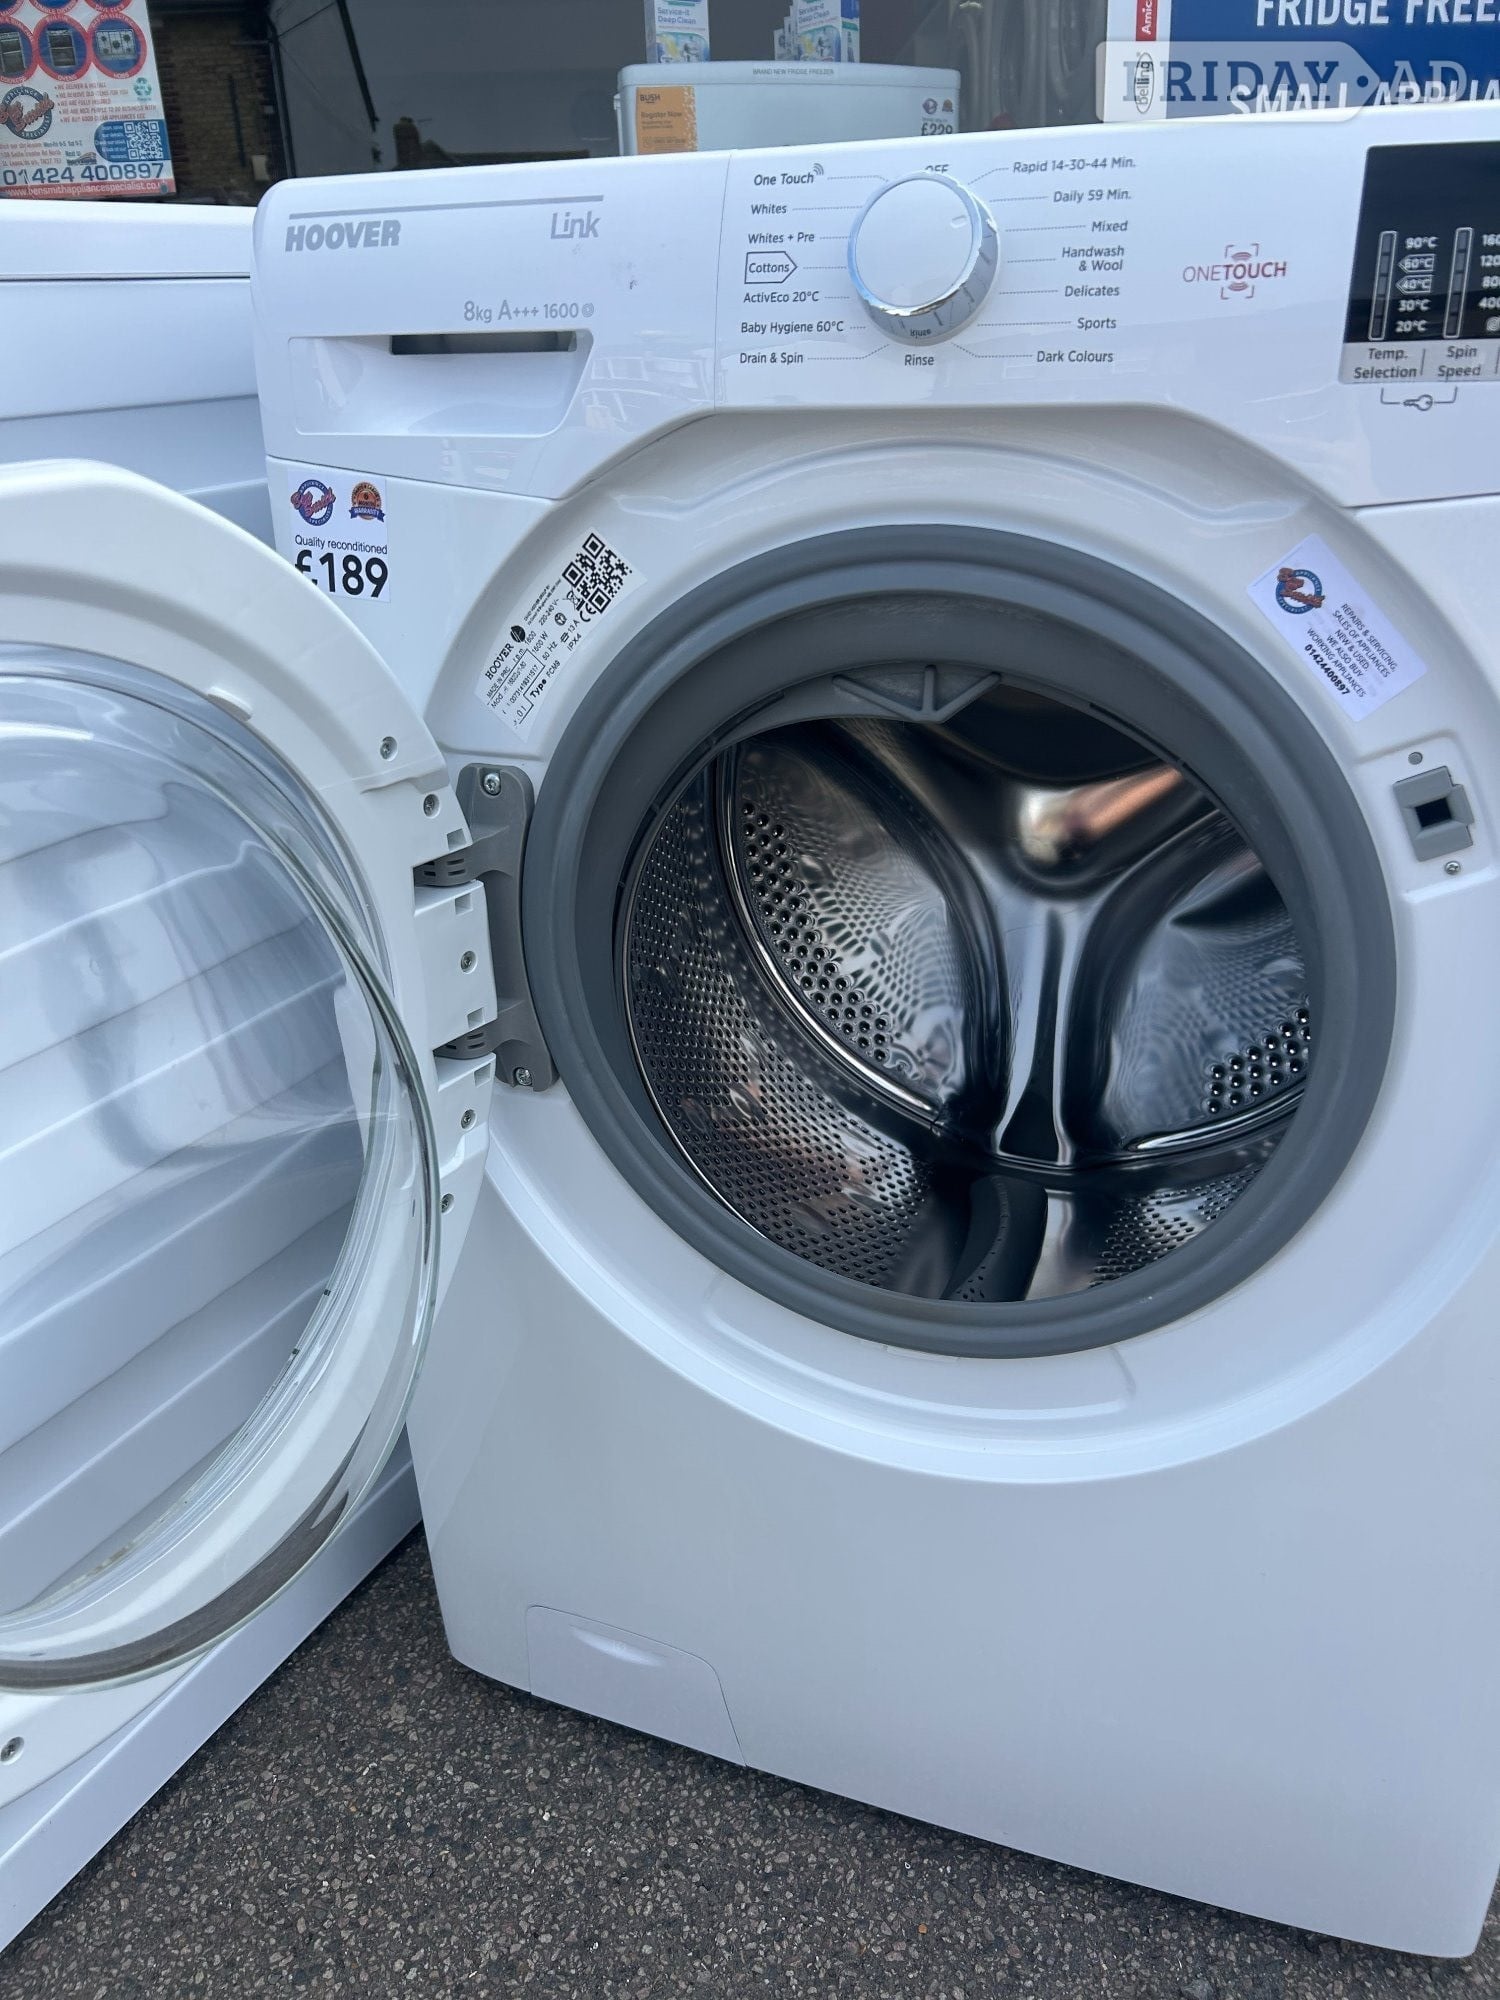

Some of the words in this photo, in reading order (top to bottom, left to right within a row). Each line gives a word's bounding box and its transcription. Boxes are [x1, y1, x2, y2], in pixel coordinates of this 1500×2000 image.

[1256, 0, 1389, 27] FRIDGE
[1405, 0, 1500, 25] FREE
[640, 94, 661, 102] BUSH
[1013, 161, 1048, 174] Rapid
[1052, 158, 1107, 171] 14-30-44
[1111, 156, 1136, 168] Min.
[3, 166, 74, 186] 01424
[81, 163, 163, 182] 400897
[753, 174, 777, 186] One
[781, 172, 814, 185] Touch
[1053, 190, 1084, 204] Daily
[1087, 190, 1103, 201] 59
[1107, 188, 1132, 201] Min.
[751, 203, 787, 215] Whites
[550, 211, 600, 240] Link
[1091, 220, 1129, 232] Mixed
[285, 219, 401, 252] HOOVER
[748, 232, 784, 244] Whites
[787, 234, 794, 242] +
[797, 232, 815, 243] Pre
[1062, 245, 1125, 258] Handwash
[748, 263, 790, 274] Cottons
[1078, 261, 1087, 272] &
[1091, 259, 1124, 272] Wool
[1183, 262, 1288, 283] ONETOUCH
[1482, 275, 1500, 289] 80
[743, 293, 790, 303] ActivEco
[1064, 285, 1120, 297] Delicates
[463, 301, 492, 323] 8kg
[498, 299, 539, 321] A+++
[543, 302, 579, 320] 1600
[741, 322, 767, 335] Baby
[770, 321, 814, 335] Hygiene
[1077, 317, 1117, 330] Sports
[740, 353, 767, 364] Drain
[770, 353, 778, 364] &
[781, 352, 804, 365] Spin
[904, 355, 935, 366] Rinse
[1036, 351, 1064, 363] Dark
[1067, 350, 1114, 363] Colours
[1368, 347, 1407, 362] Temp.
[1446, 345, 1477, 359] Spin
[1353, 366, 1417, 380] Selection
[1438, 364, 1481, 382] Speed
[295, 534, 325, 549] Quality
[327, 540, 388, 555] reconditioned
[295, 549, 388, 598] £189
[1341, 603, 1366, 631] REPAIRS
[539, 631, 549, 641] W
[1332, 610, 1351, 631] SALES
[1348, 629, 1359, 640] OF
[1356, 638, 1391, 678] APPLIANCES
[1334, 629, 1350, 646] NEW
[546, 640, 558, 653] Hz
[484, 642, 515, 680] HOOVER
[1306, 628, 1335, 661] WORKING
[1331, 659, 1366, 698] APPLIANCES
[1326, 635, 1338, 647] WE
[1335, 646, 1352, 665] ALSO
[1349, 663, 1364, 678] BUY
[530, 677, 549, 699] Type
[566, 632, 583, 651] IPX4
[1304, 643, 1350, 696] 01424400897
